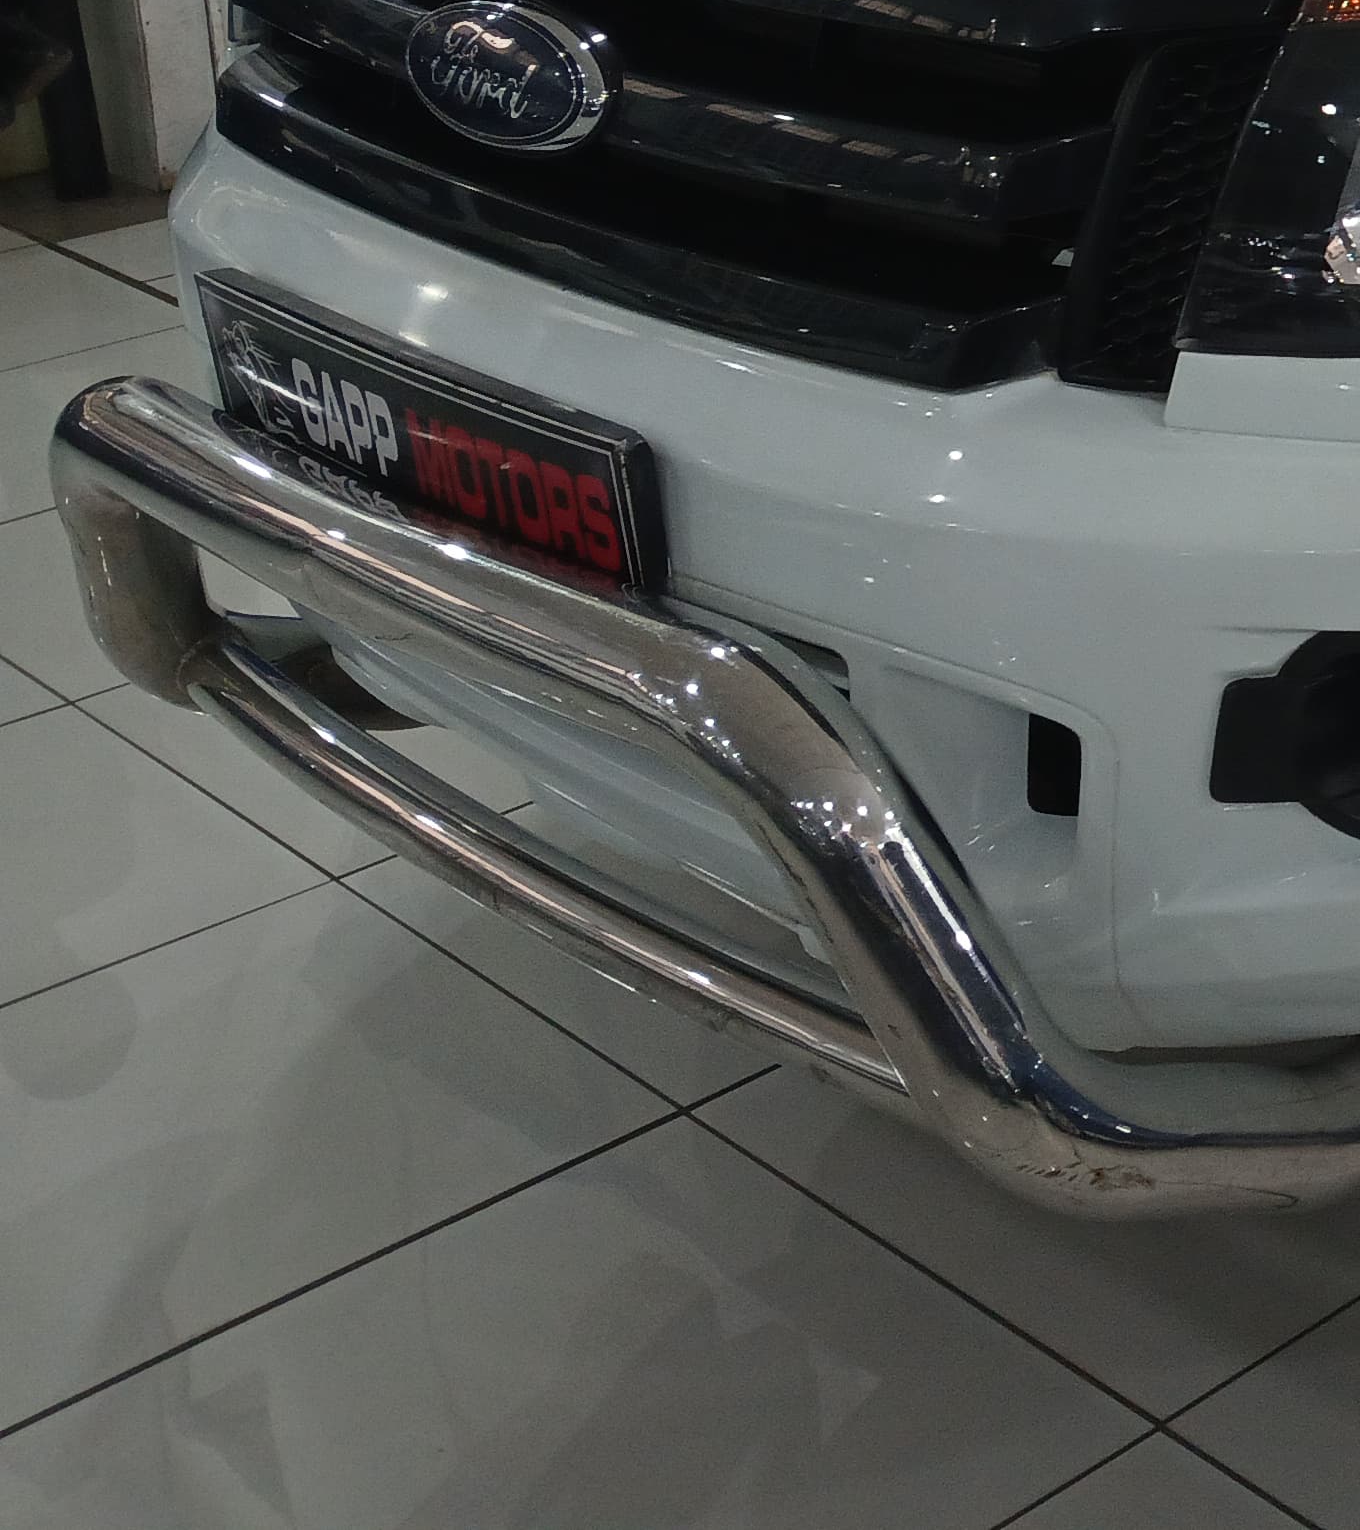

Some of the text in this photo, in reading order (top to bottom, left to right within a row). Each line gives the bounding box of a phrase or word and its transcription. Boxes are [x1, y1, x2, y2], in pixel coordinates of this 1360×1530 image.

[431, 20, 537, 119] Ford
[291, 358, 398, 476] GAPP
[405, 407, 620, 571] MOTORS
